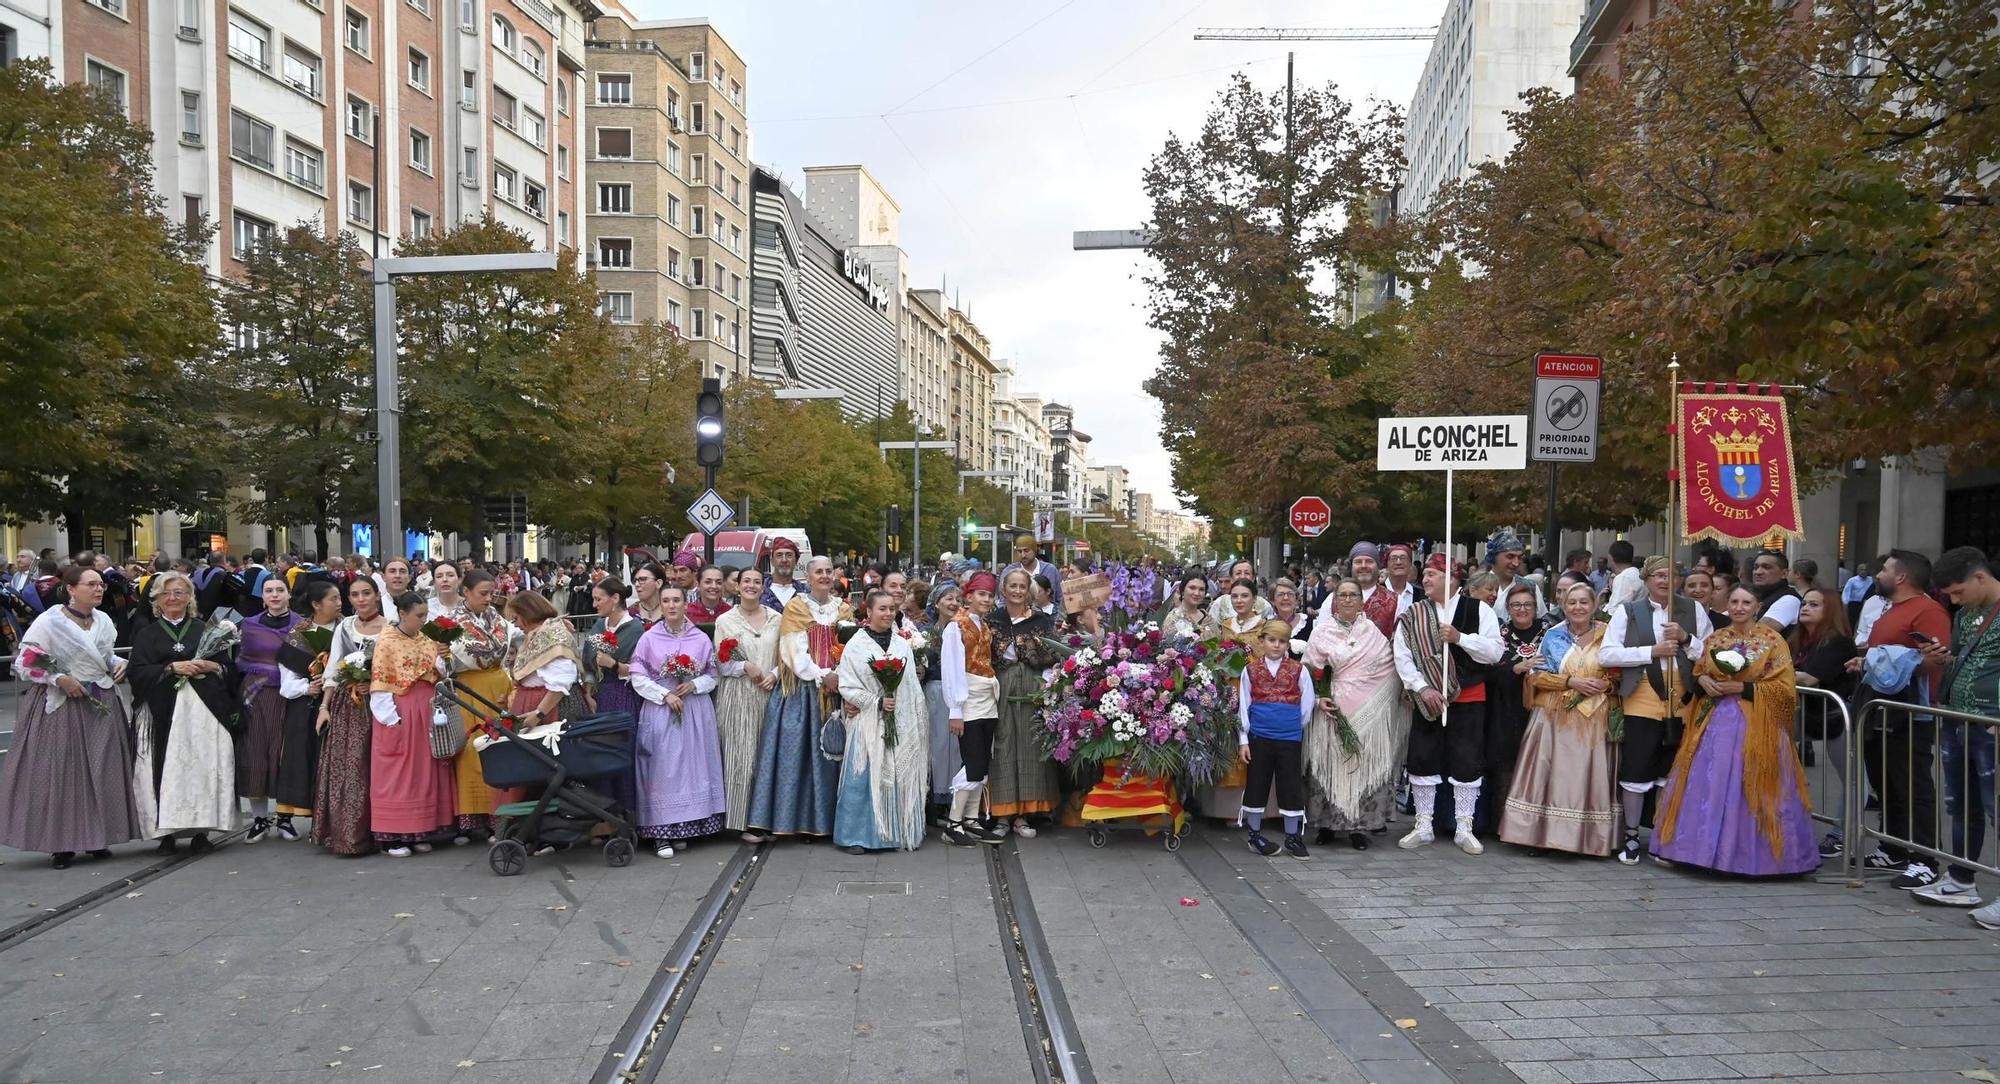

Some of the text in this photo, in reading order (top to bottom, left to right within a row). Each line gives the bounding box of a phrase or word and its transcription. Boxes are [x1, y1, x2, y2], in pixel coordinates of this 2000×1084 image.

[1544, 362, 1593, 372] ATENCIÓN
[1551, 397, 1582, 418] 20
[1387, 424, 1518, 449] ALCONCHEL
[1540, 434, 1590, 443] PRIORIDAD
[1415, 449, 1488, 461] DE ARIZA
[1540, 446, 1589, 455] PEATONAL
[1696, 458, 1780, 520] ALCONCHEL DE ARIZA
[700, 504, 721, 520] 30
[1295, 512, 1326, 521] STOP
